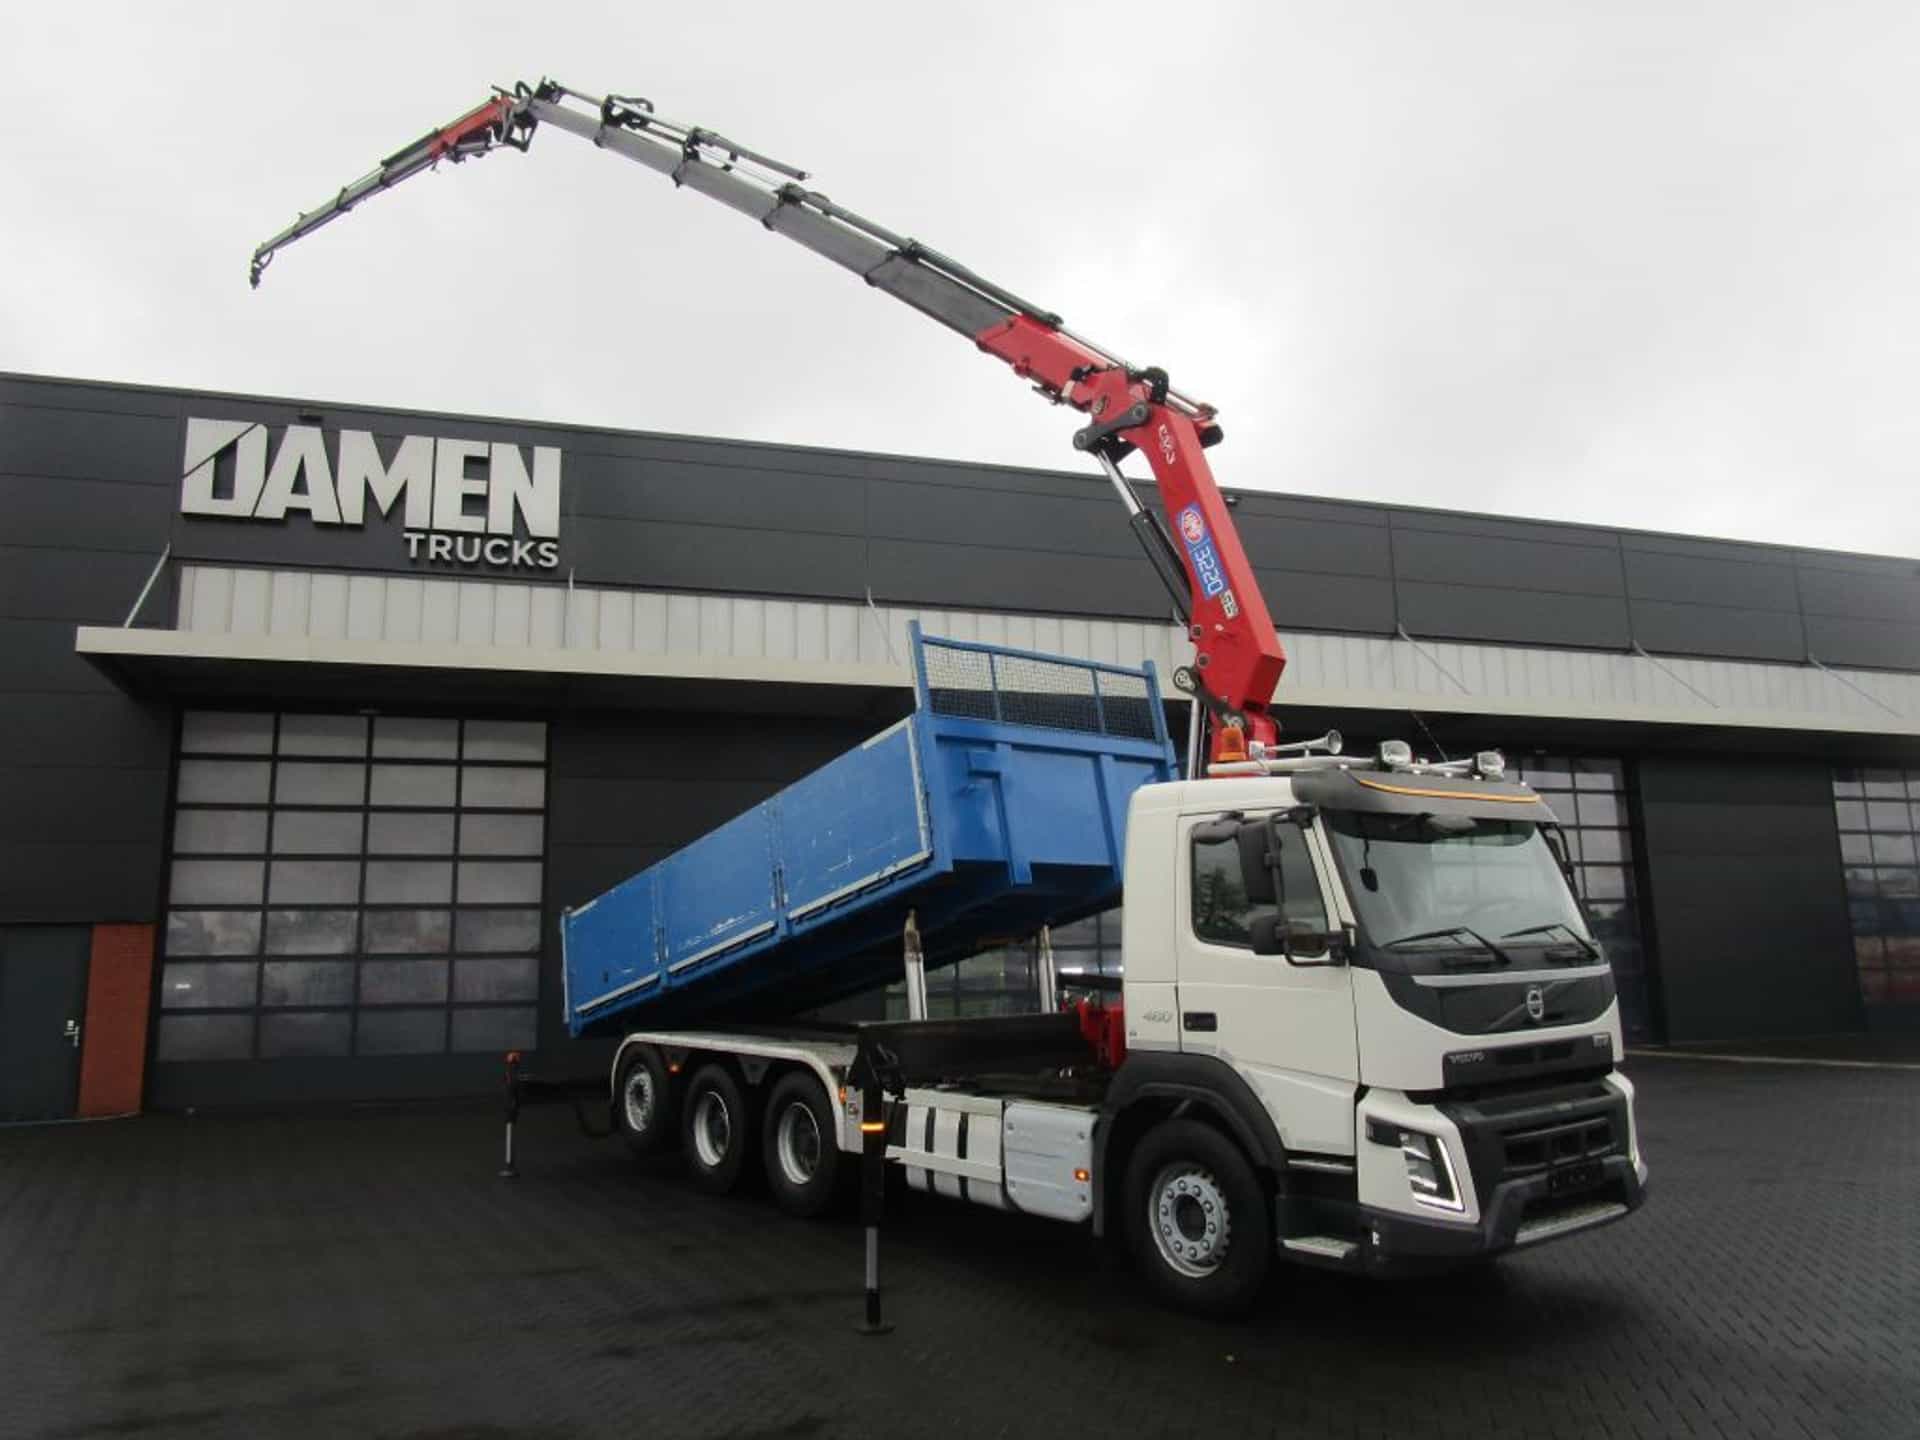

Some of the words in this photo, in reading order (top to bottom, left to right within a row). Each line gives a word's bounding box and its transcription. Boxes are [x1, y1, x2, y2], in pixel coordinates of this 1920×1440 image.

[180, 417, 562, 537] DAMEN
[403, 532, 559, 568] TRUCKS
[1194, 545, 1224, 598] 3220
